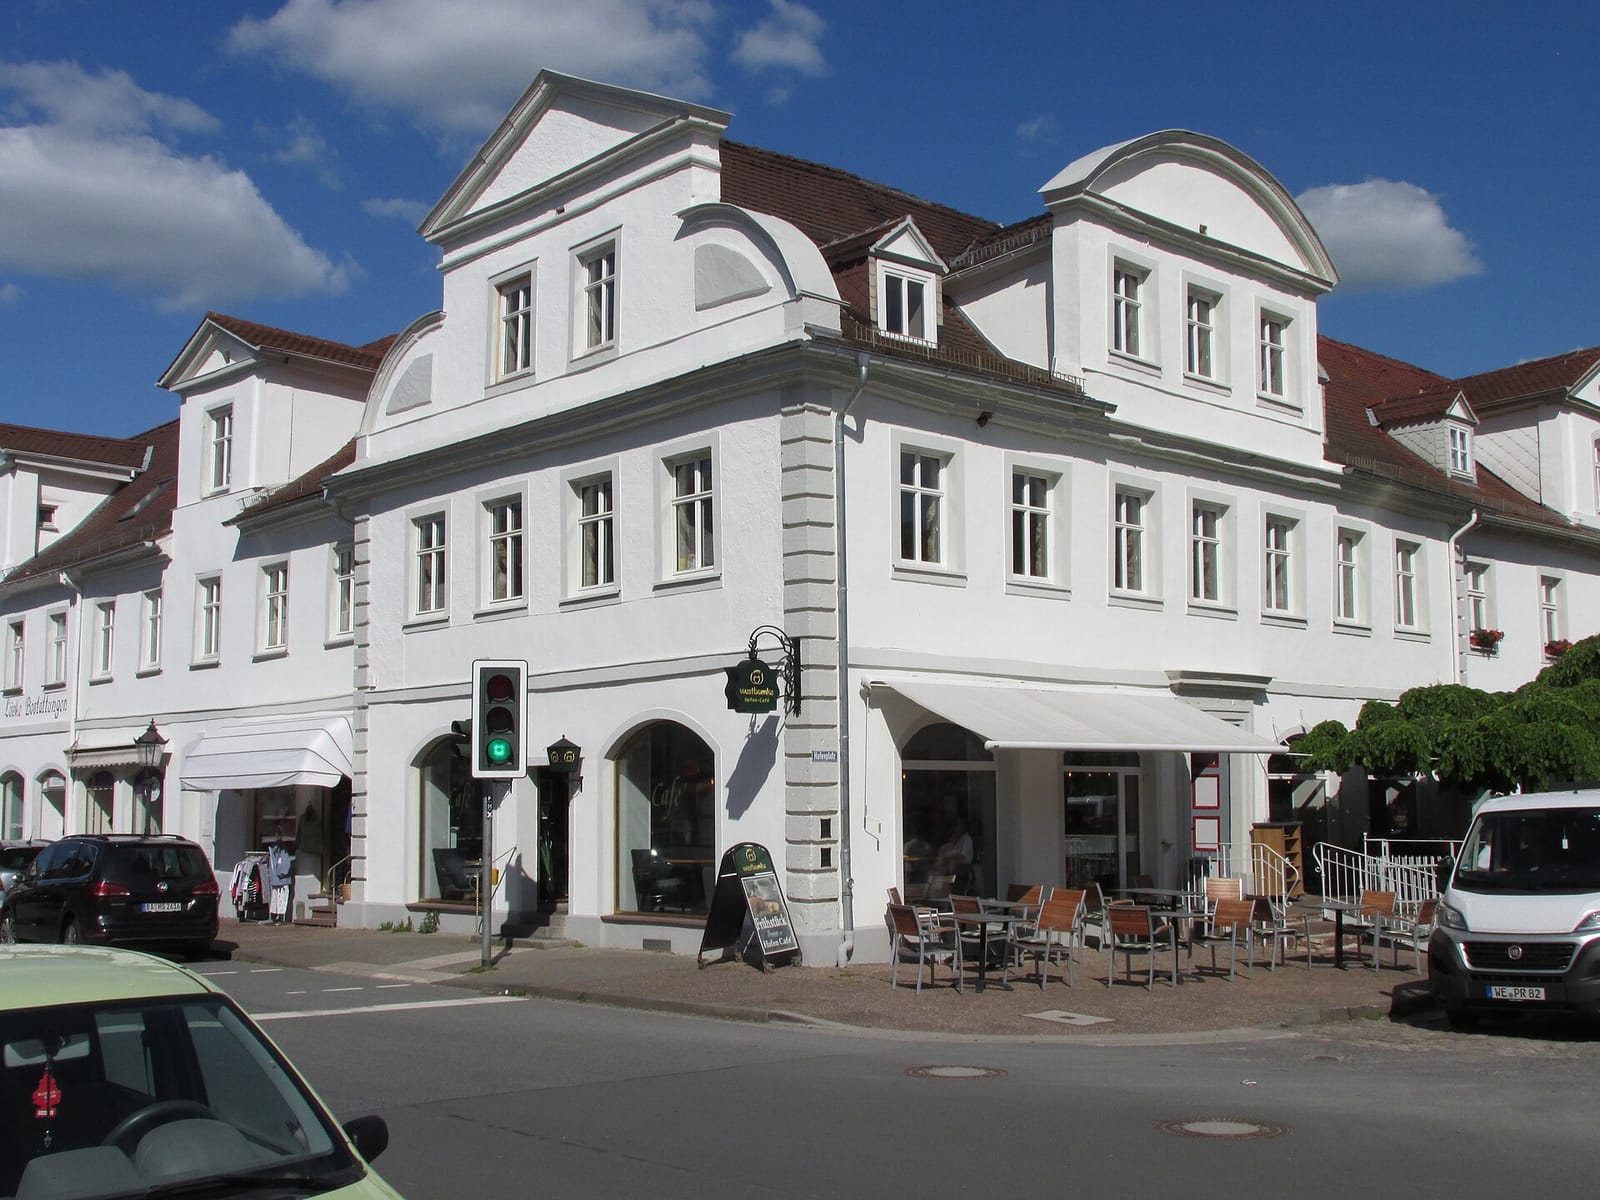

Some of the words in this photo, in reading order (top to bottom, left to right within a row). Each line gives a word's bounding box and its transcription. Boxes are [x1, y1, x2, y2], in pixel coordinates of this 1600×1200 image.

[754, 913, 787, 930] Frühstück
[1494, 987, 1508, 998] WE
[1513, 988, 1527, 998] PR
[1528, 988, 1541, 999] 82
